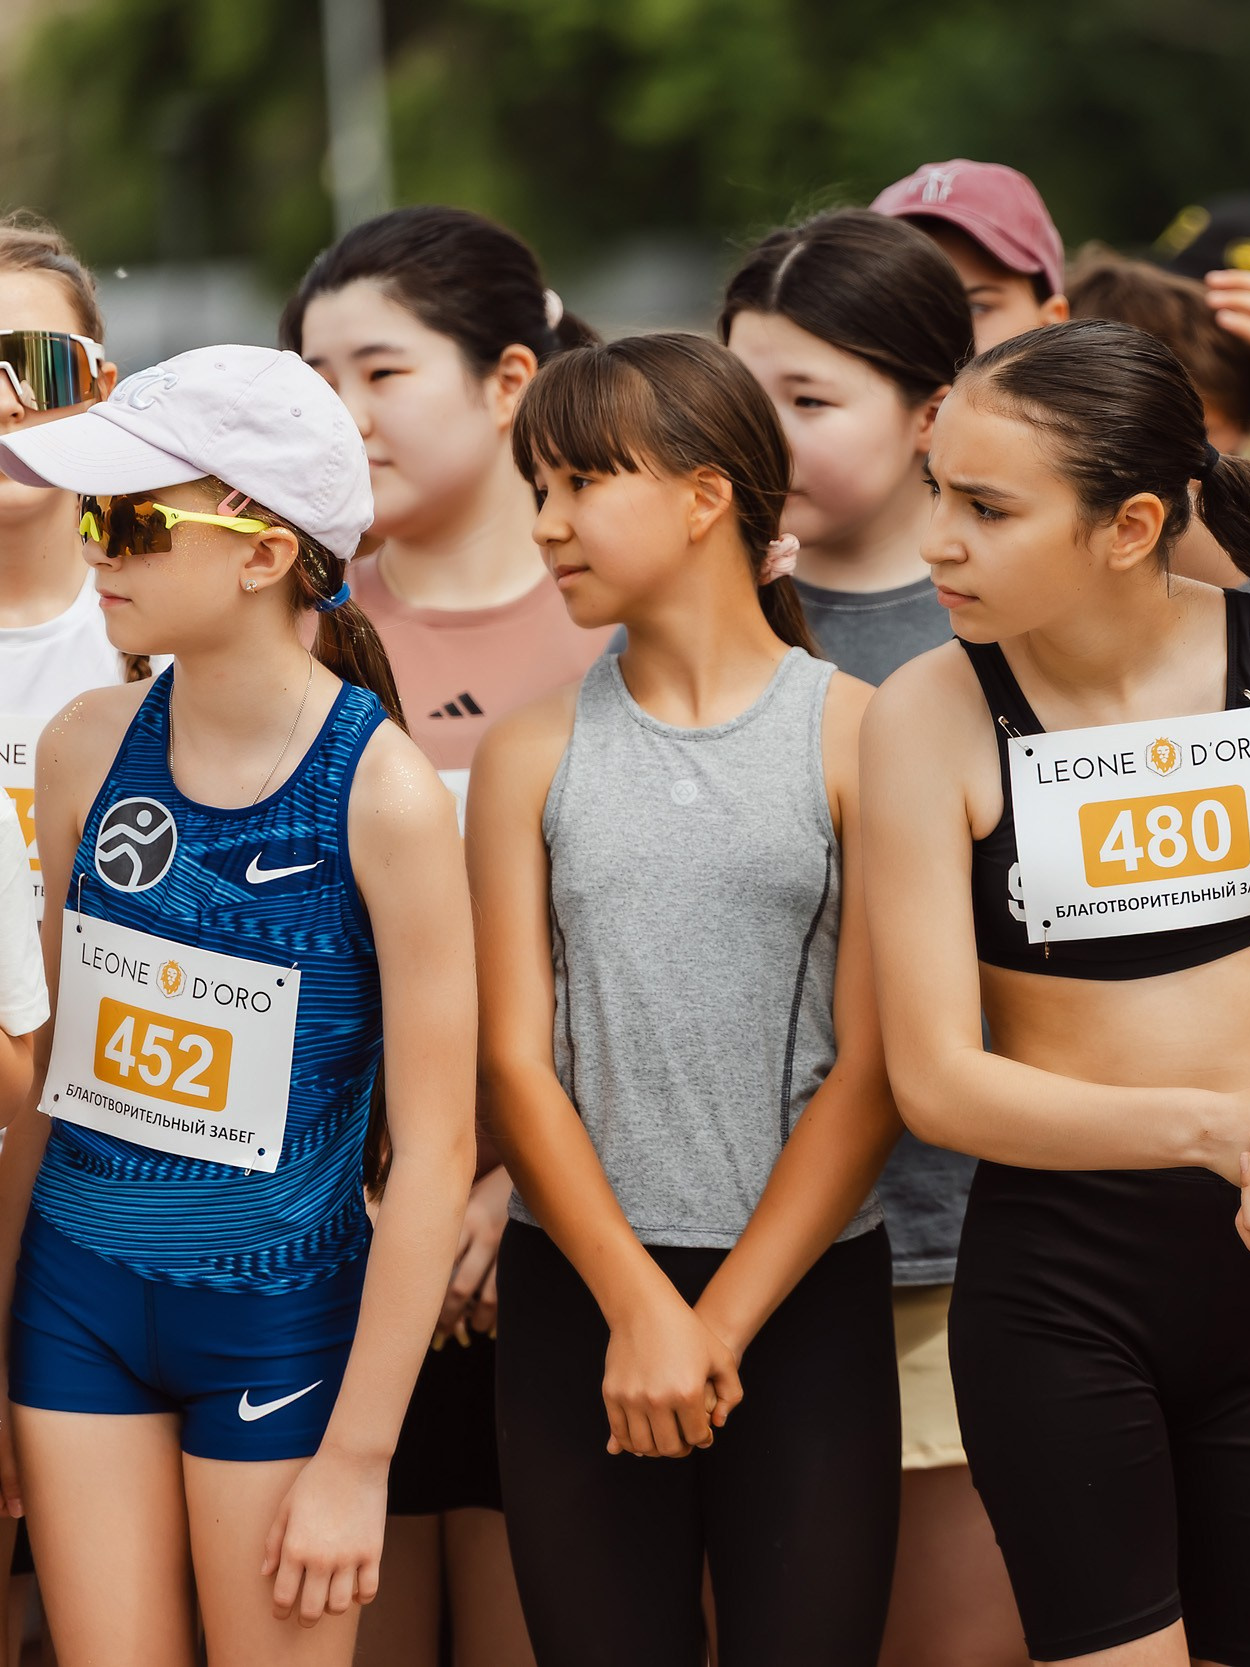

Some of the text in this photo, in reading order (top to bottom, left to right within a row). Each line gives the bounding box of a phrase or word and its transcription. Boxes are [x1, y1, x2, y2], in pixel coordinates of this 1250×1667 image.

[1036, 751, 1137, 785] LEONE
[1099, 799, 1232, 872] 480
[1055, 881, 1237, 919] БЛАГОТВОРИТЕЛЬНЫЙ
[81, 943, 272, 1013] LEONE D'ORO
[104, 1015, 215, 1098] 452
[65, 1083, 257, 1145] БЛАГОТВОРИТЕЛЬНЫЙ ЗАБЕГ
